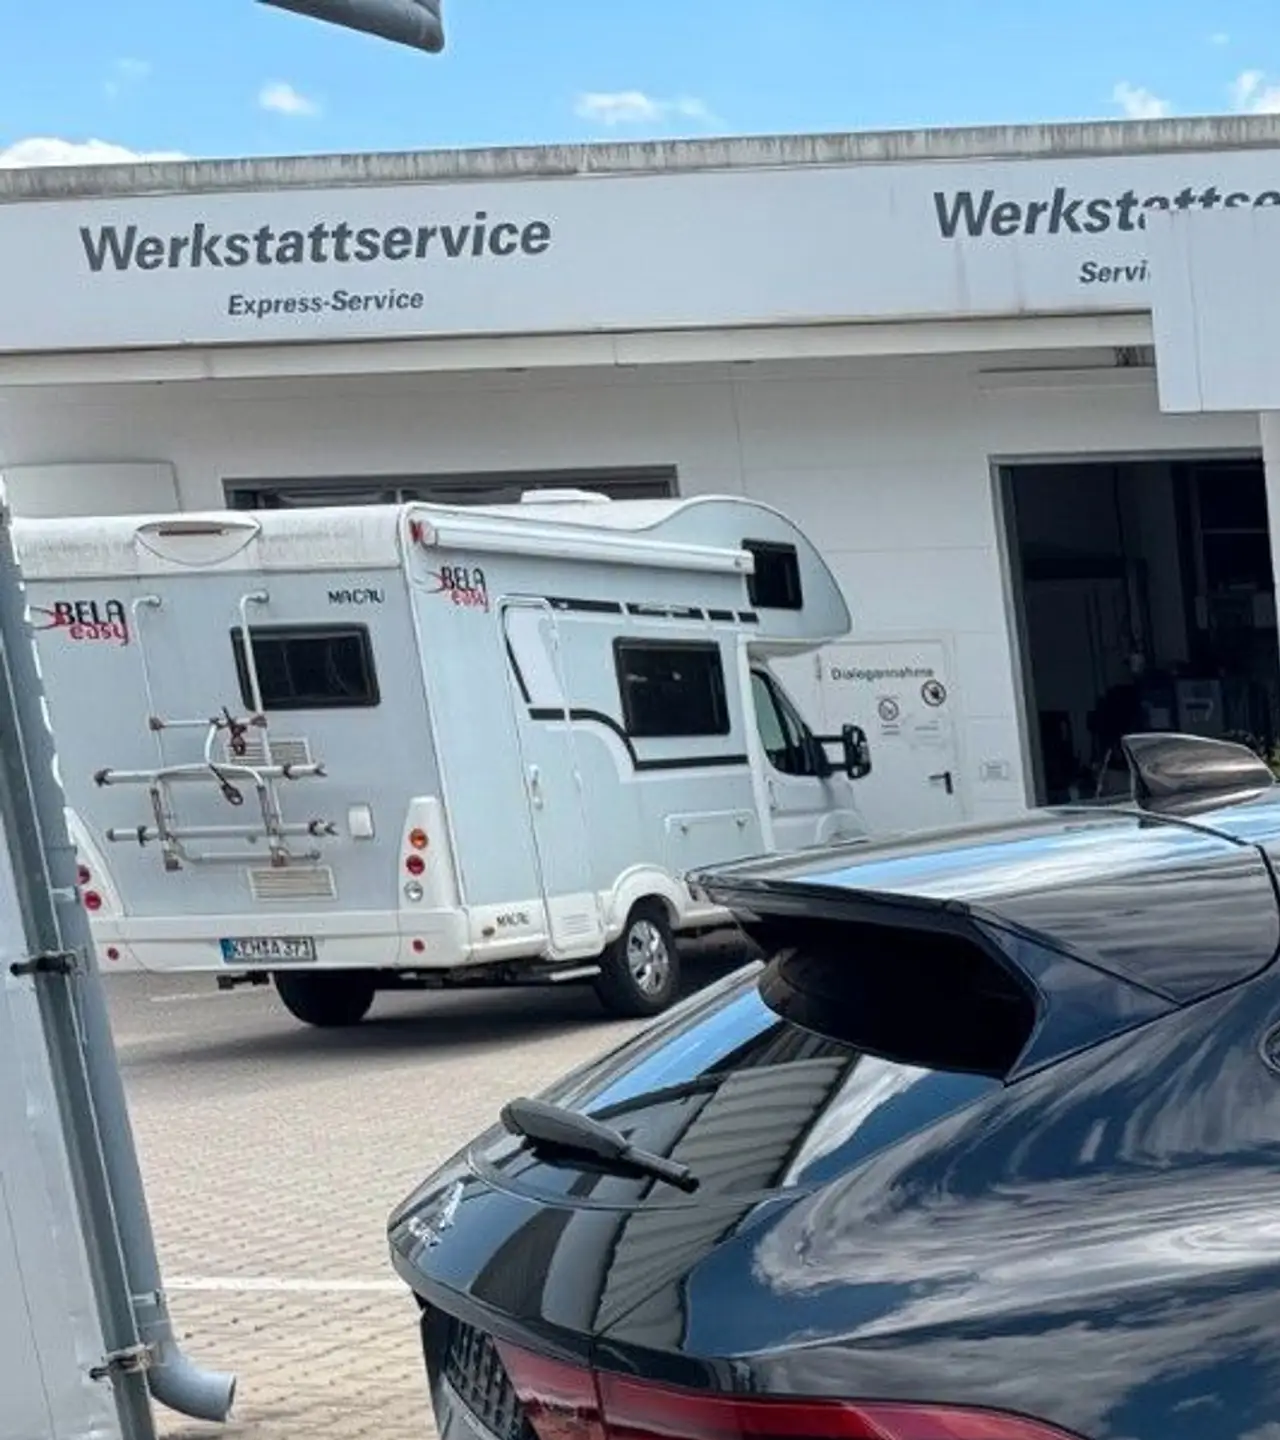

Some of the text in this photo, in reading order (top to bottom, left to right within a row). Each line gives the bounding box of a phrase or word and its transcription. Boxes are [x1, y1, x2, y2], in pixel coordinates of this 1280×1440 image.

[79, 211, 552, 272] Werkstattservice
[1079, 259, 1152, 284] Servi
[227, 288, 425, 318] Express-Service
[440, 565, 488, 592] BELA
[54, 599, 126, 625] BELA
[69, 622, 129, 647] easy
